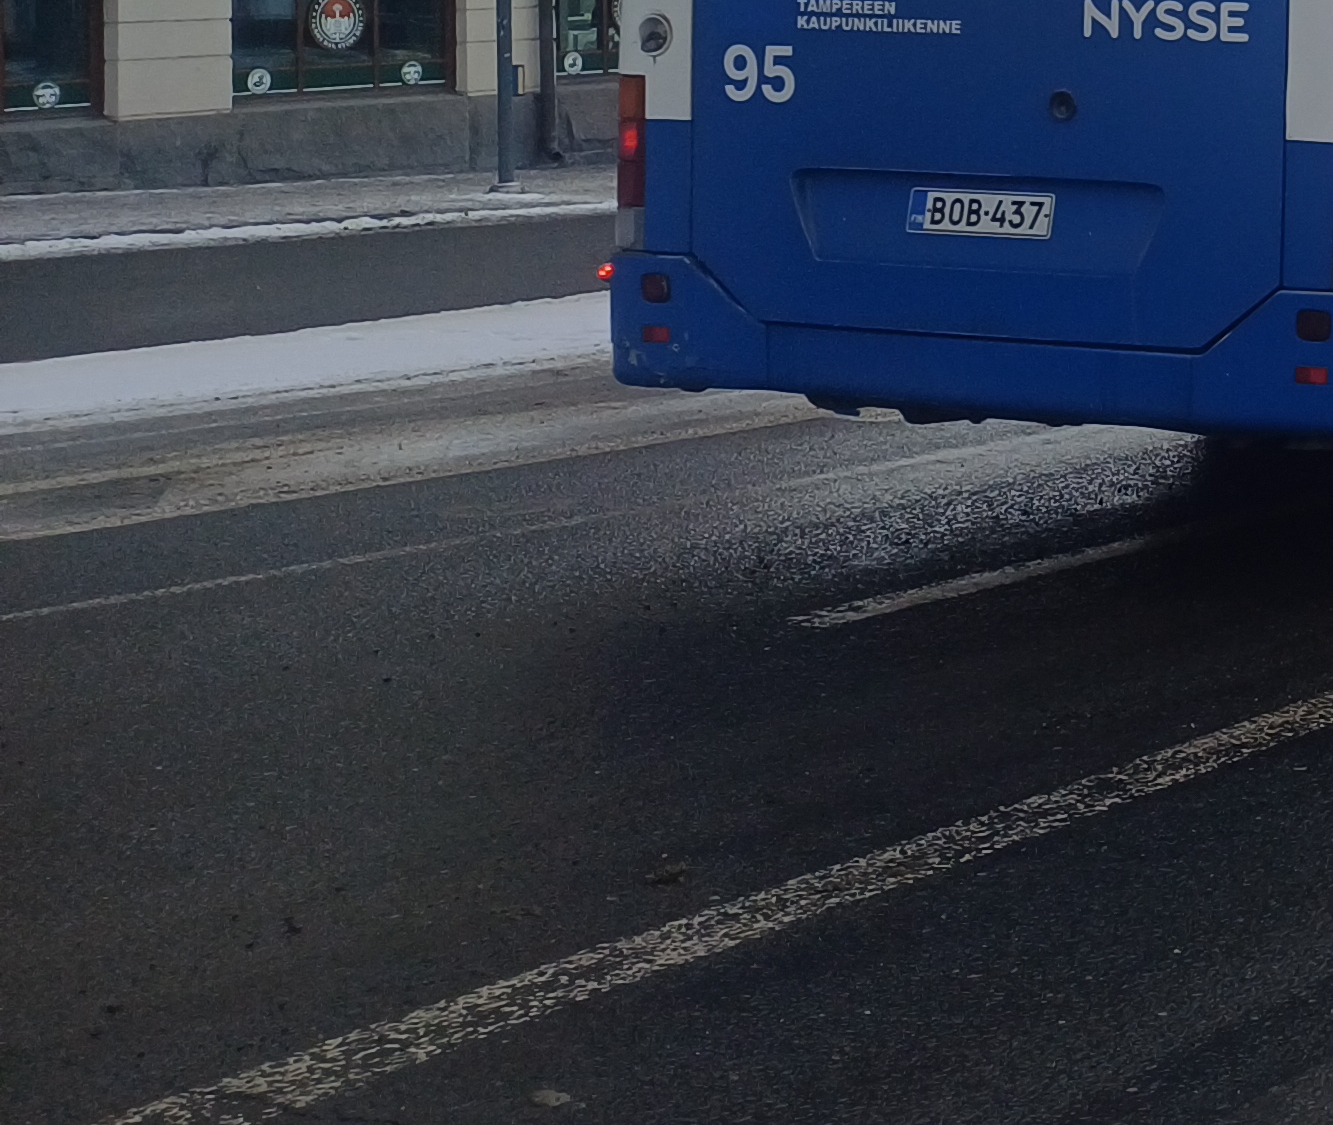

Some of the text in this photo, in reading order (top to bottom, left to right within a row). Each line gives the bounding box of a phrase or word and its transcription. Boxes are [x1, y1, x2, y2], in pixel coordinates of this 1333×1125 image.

[797, 15, 962, 35] KAUPUNKILIIKENNE
[723, 45, 796, 103] 95
[930, 197, 1045, 230] BOB-437
